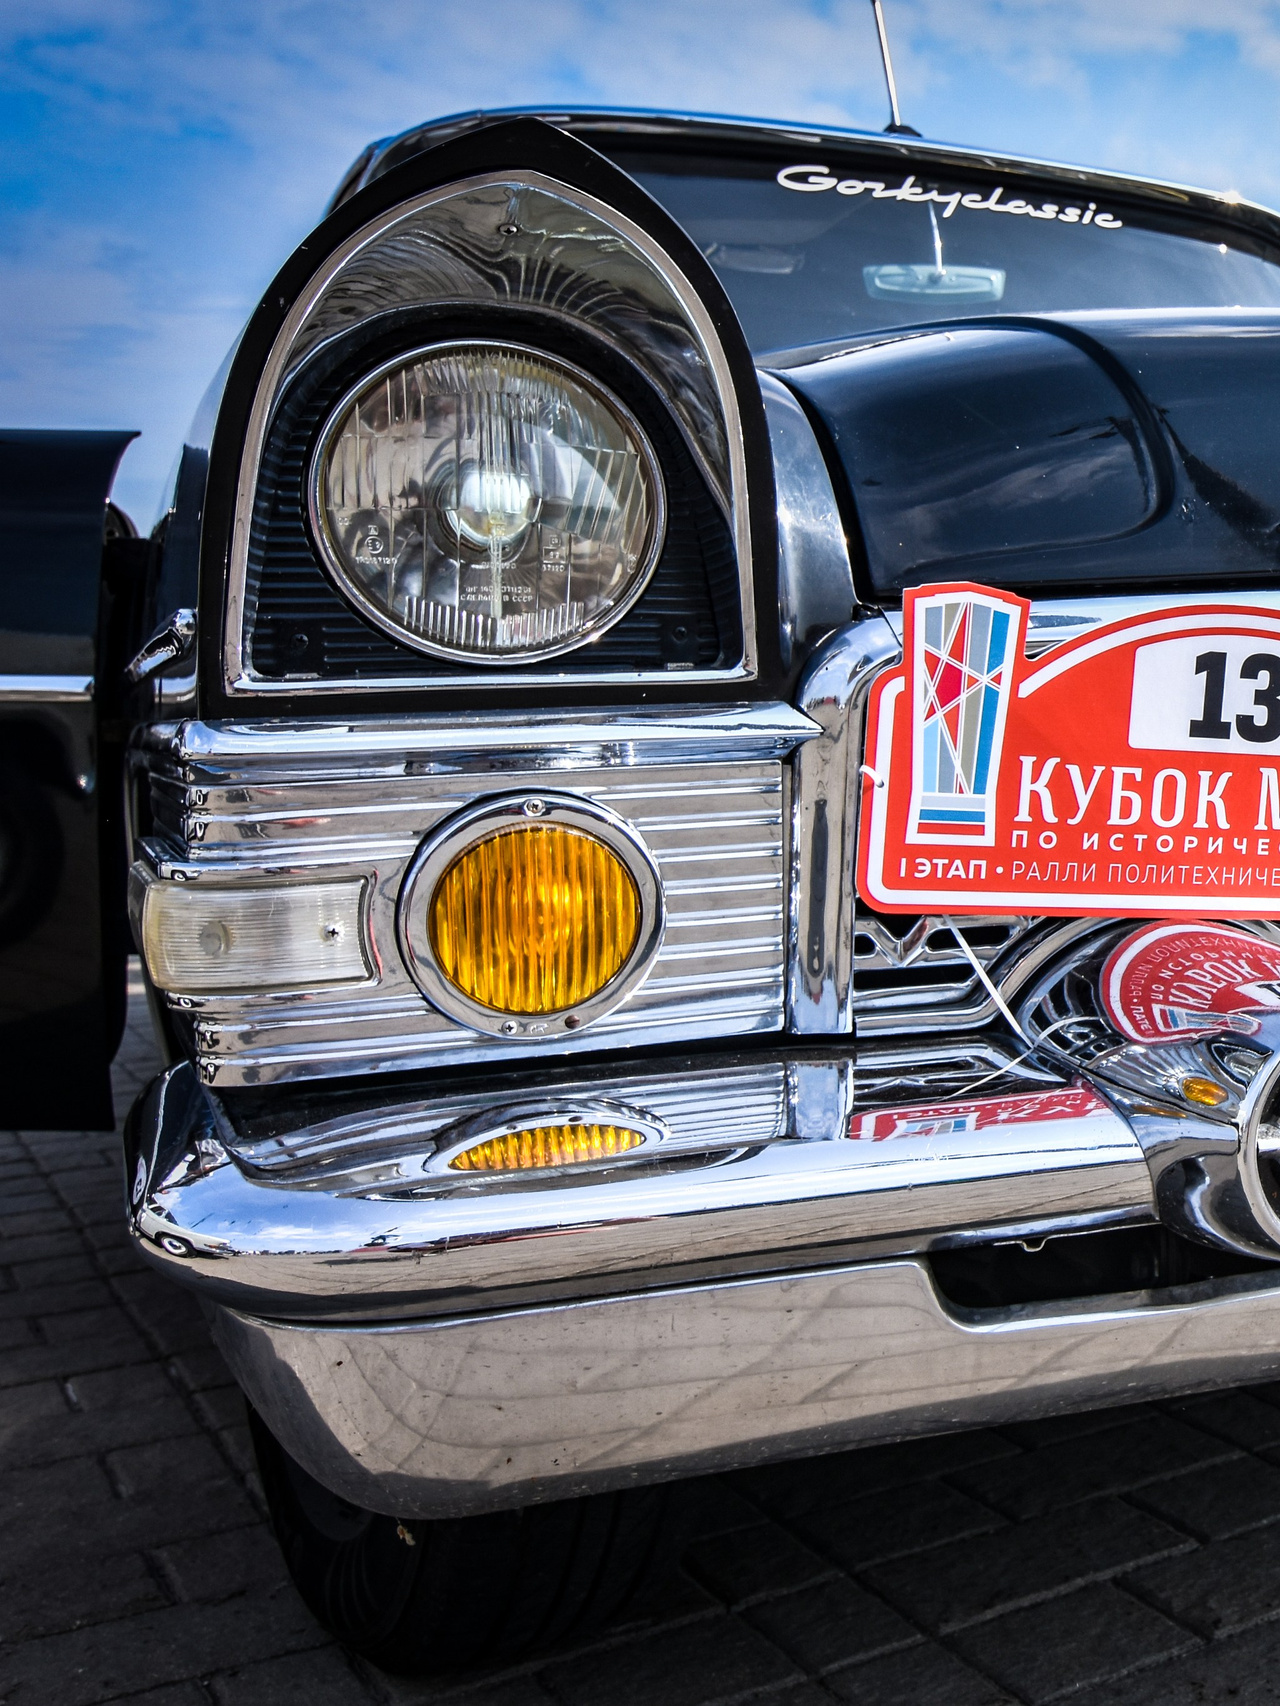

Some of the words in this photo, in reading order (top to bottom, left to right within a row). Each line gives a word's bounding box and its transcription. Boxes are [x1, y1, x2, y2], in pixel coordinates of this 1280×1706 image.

[777, 165, 1123, 229] Gorkyclassic
[1011, 830, 1058, 850] ПО
[913, 858, 988, 880] ЭТАП
[1010, 861, 1097, 883] РАЛЛИ
